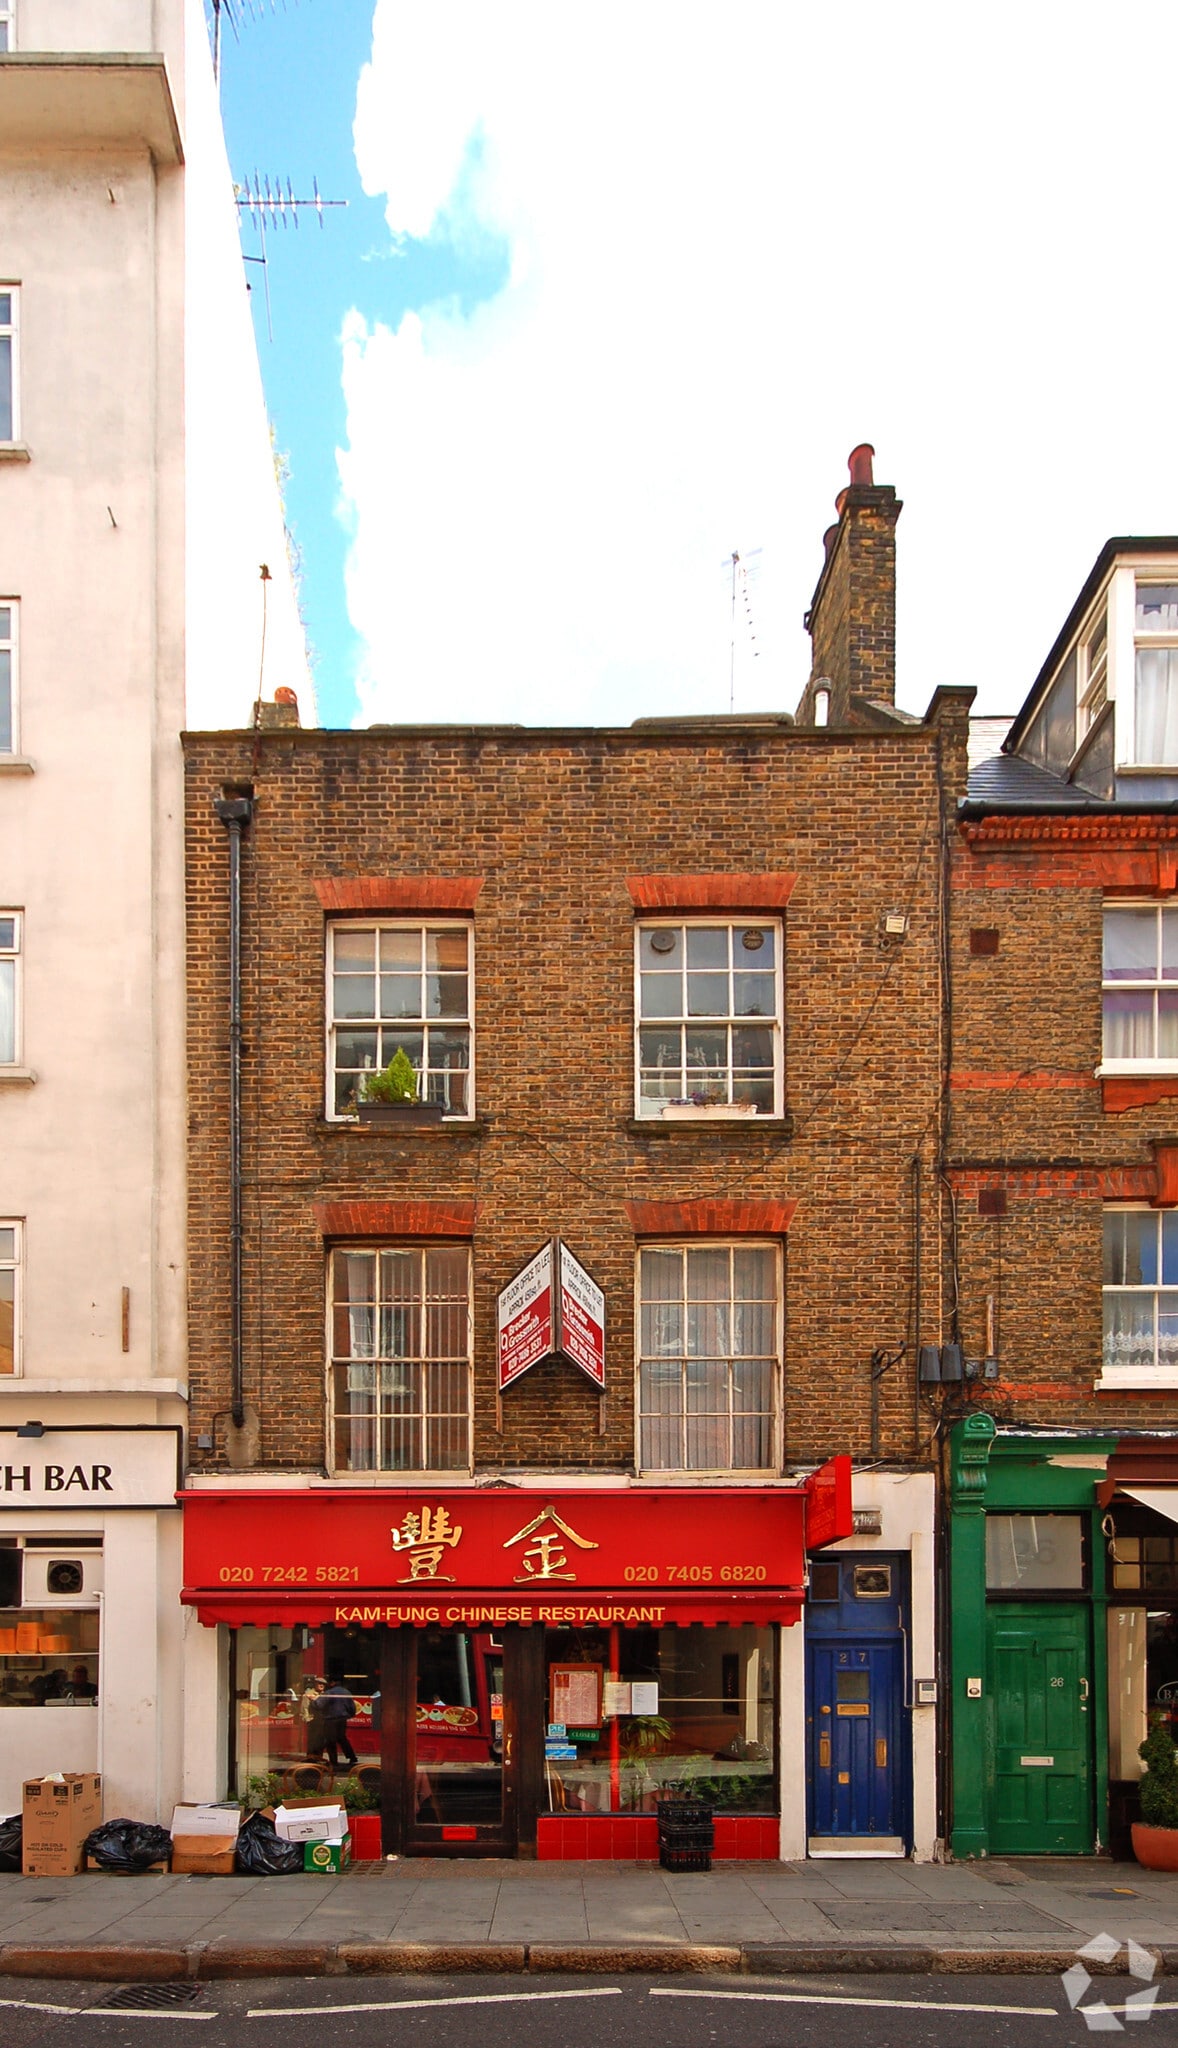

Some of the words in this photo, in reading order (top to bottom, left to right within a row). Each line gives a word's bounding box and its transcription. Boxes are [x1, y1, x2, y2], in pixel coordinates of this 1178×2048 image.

[45, 1465, 114, 1491] BAR
[219, 1567, 254, 1582] 020
[261, 1567, 308, 1582] 7242
[315, 1567, 359, 1582] 5821
[624, 1566, 658, 1581] 020
[666, 1566, 713, 1581] 7405
[720, 1566, 767, 1581] 6820
[335, 1607, 440, 1621] KAM-FUNG
[446, 1607, 532, 1621] CHINESE
[538, 1607, 666, 1621] RESTAURANT
[1050, 1677, 1064, 1687] 26
[571, 1731, 596, 1739] CLOSED
